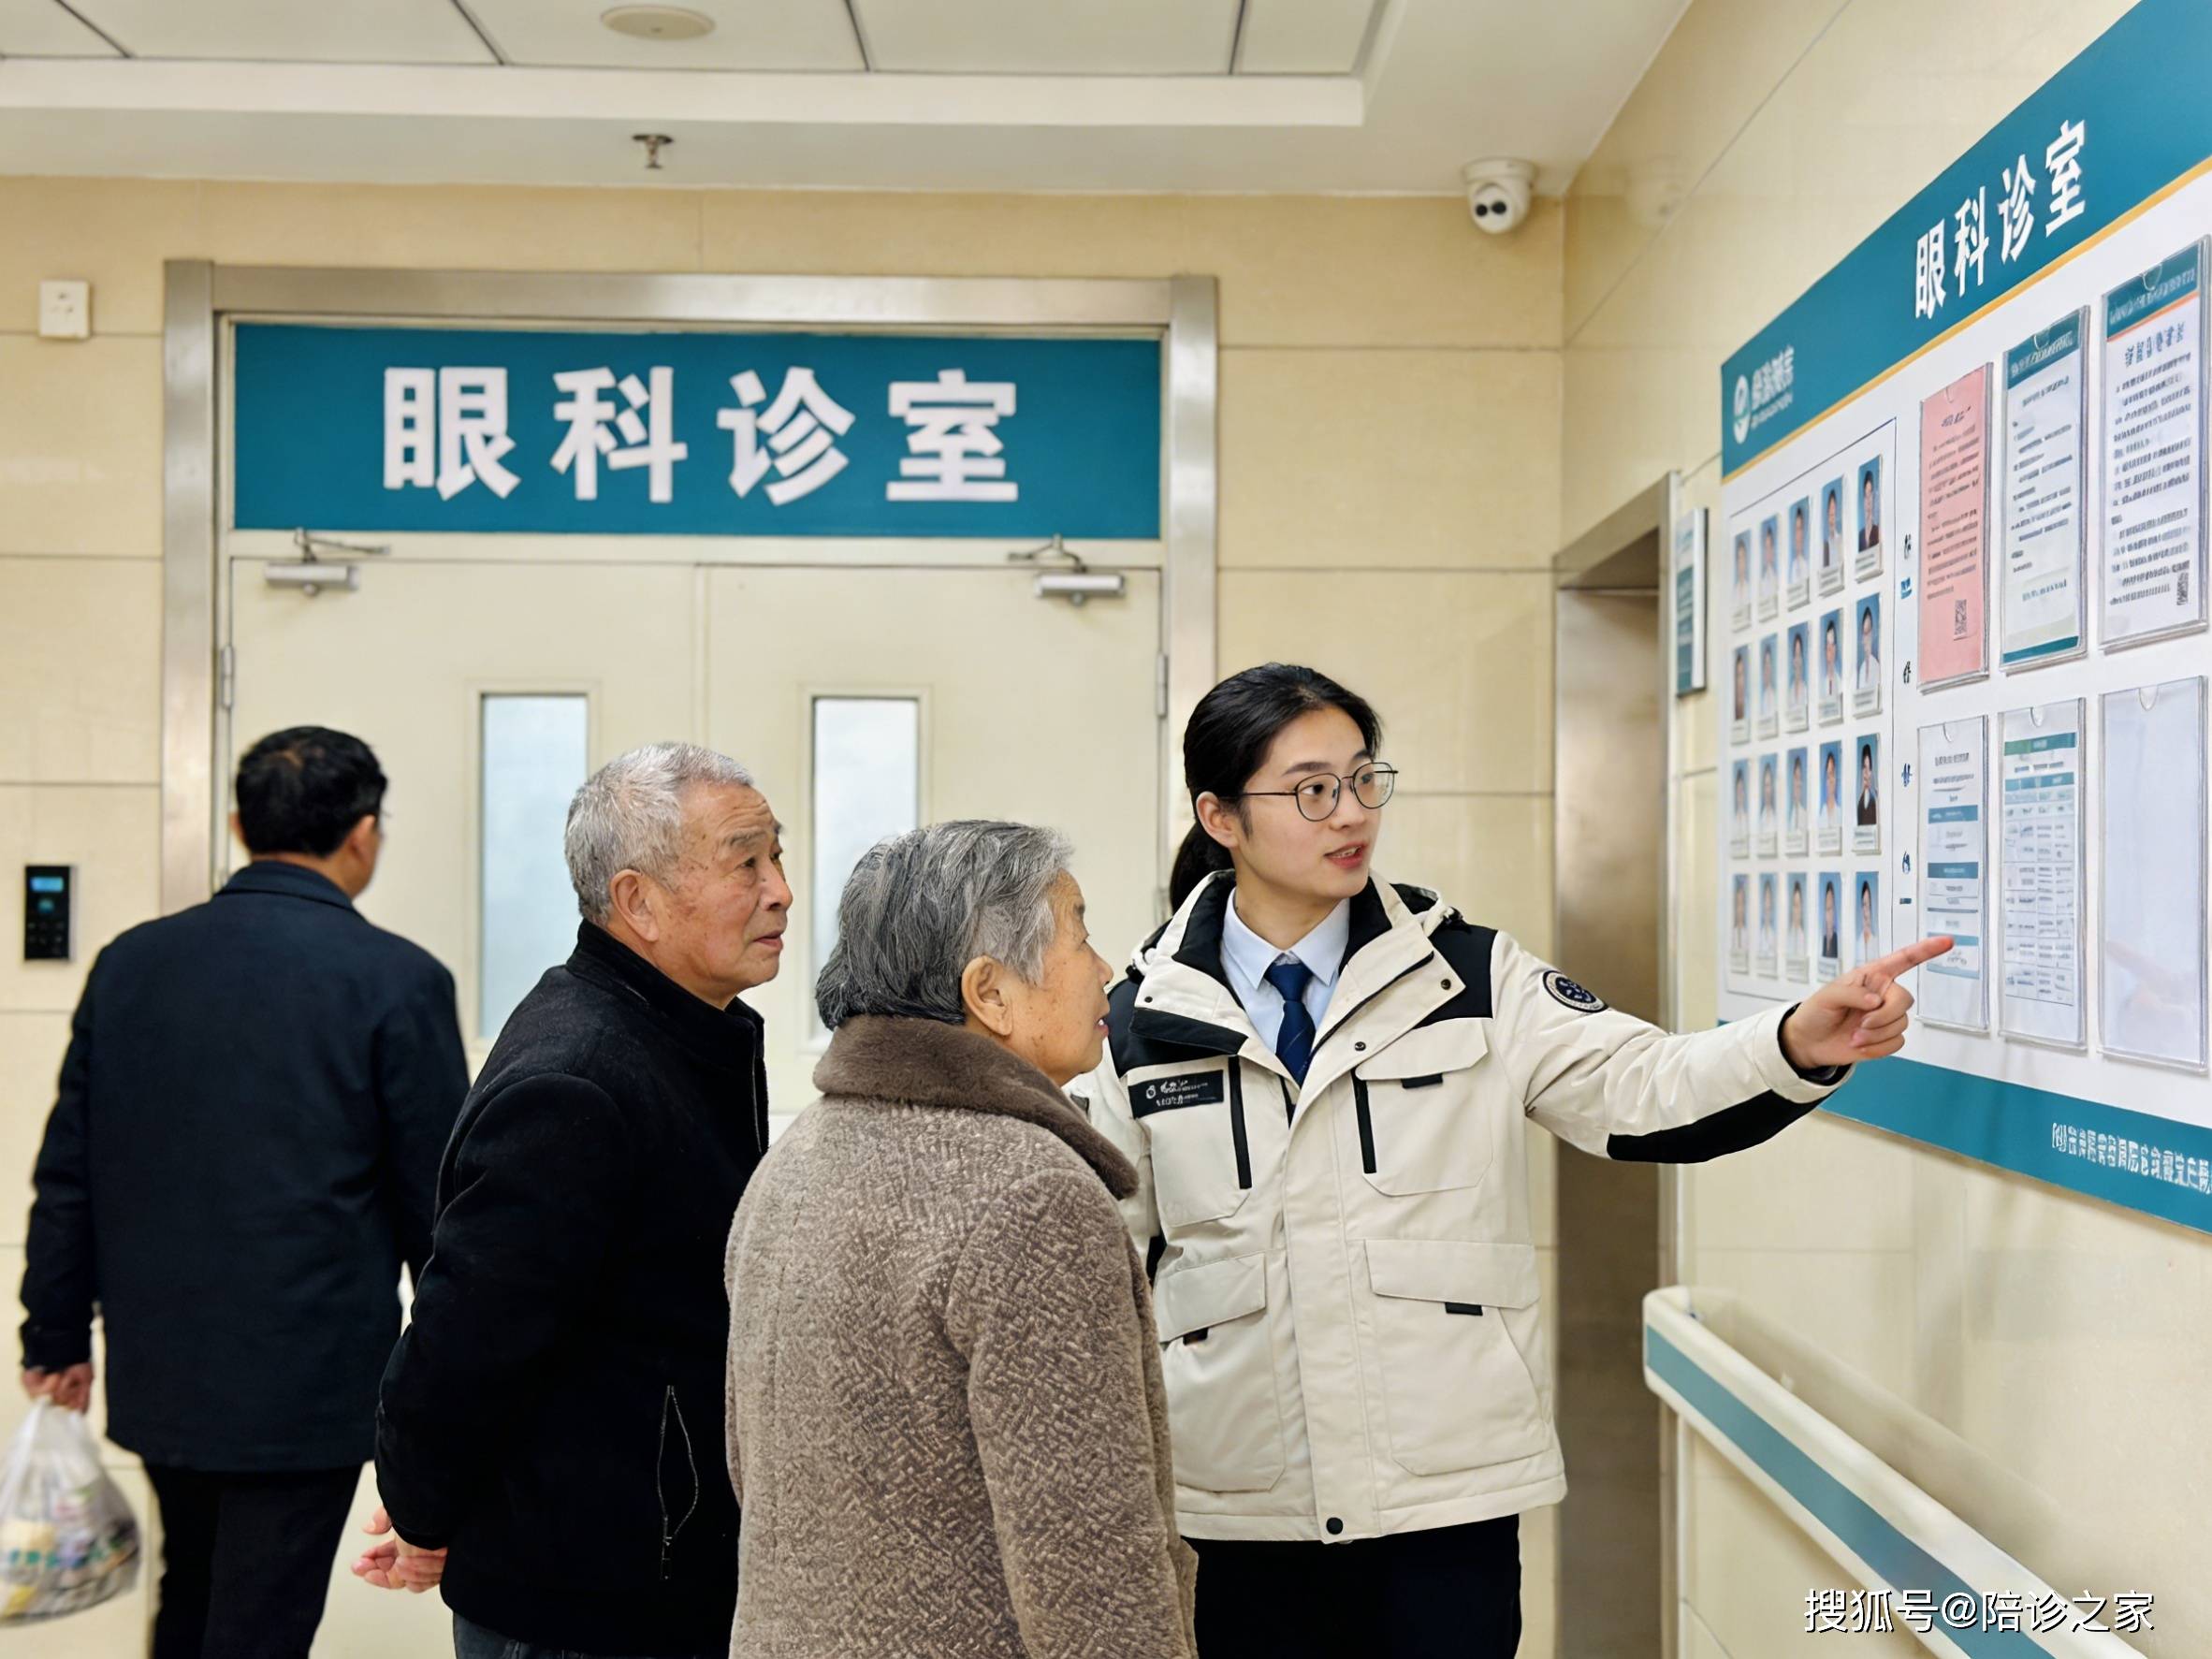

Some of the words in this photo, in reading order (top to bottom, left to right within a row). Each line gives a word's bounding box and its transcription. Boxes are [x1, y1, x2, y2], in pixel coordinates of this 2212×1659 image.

[1914, 118, 2087, 319] 眼科诊室
[382, 366, 1019, 505] 眼科诊室
